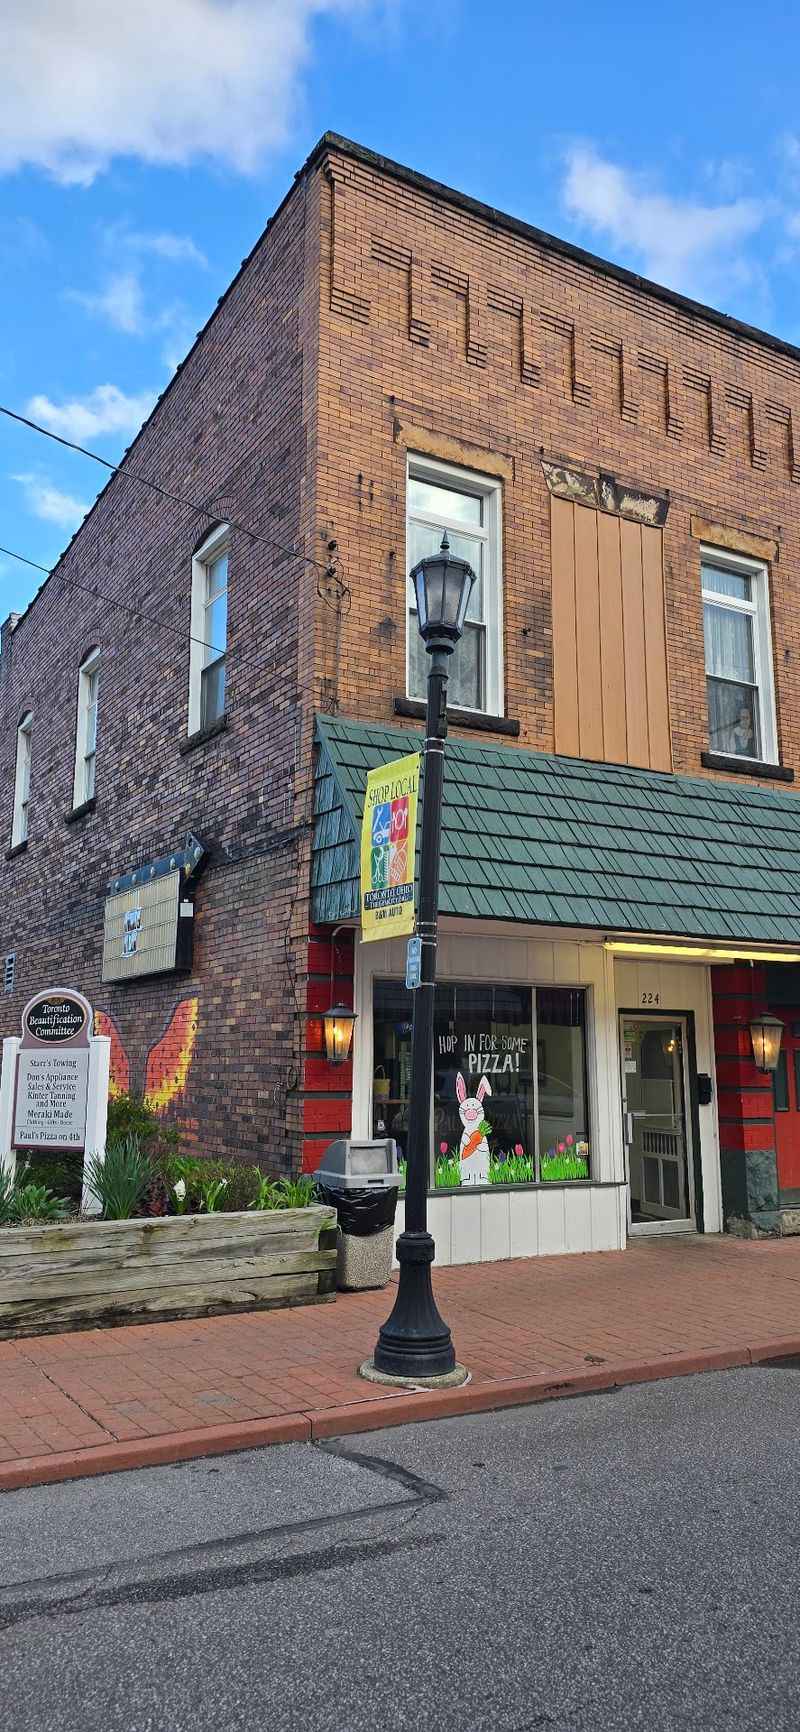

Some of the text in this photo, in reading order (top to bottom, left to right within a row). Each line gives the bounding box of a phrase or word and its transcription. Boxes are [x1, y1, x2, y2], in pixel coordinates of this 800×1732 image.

[367, 775, 416, 808] SHOP LOCAL
[641, 992, 659, 1005] 224
[42, 1004, 70, 1013] Toronto
[29, 1013, 83, 1028] Beautification
[36, 1026, 75, 1036] Committee
[439, 1033, 529, 1054] HOP IN FOR SOME
[30, 1059, 77, 1068] Starr's Towing
[468, 1052, 520, 1073] PIZZA!
[46, 1073, 79, 1082] Appliance
[28, 1082, 44, 1090] Sales
[49, 1091, 76, 1101] Tanning
[27, 1110, 73, 1119] Meraki Made
[20, 1130, 39, 1140] Paul's
[40, 1131, 58, 1141] Pizza
[69, 1132, 81, 1141] 4th
